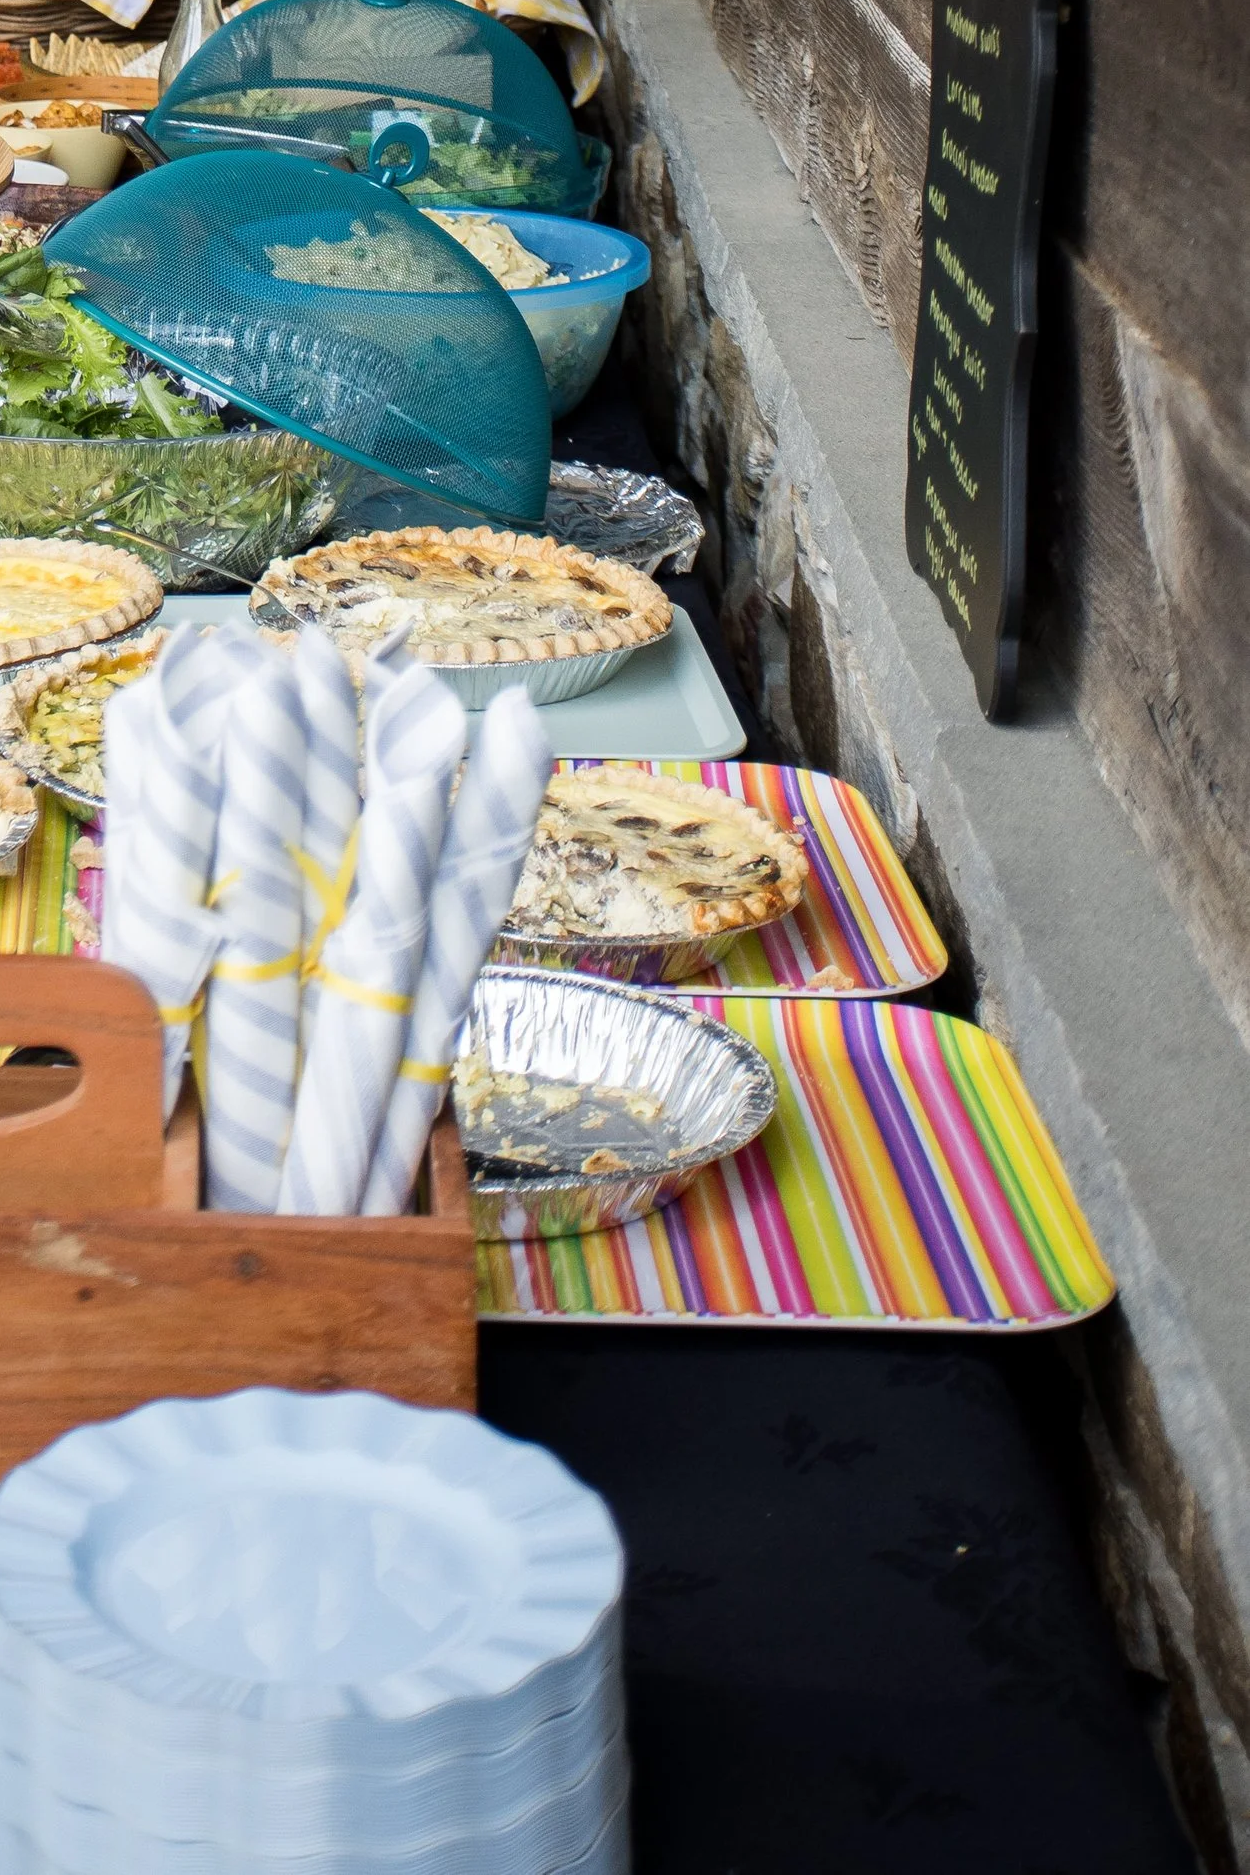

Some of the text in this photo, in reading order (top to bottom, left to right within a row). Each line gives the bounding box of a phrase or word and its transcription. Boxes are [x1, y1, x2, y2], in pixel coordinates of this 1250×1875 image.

[947, 73, 983, 122] Lorraine
[942, 128, 968, 177] Broccoli
[934, 357, 963, 424] Lorraine
[926, 395, 941, 438] Ham
